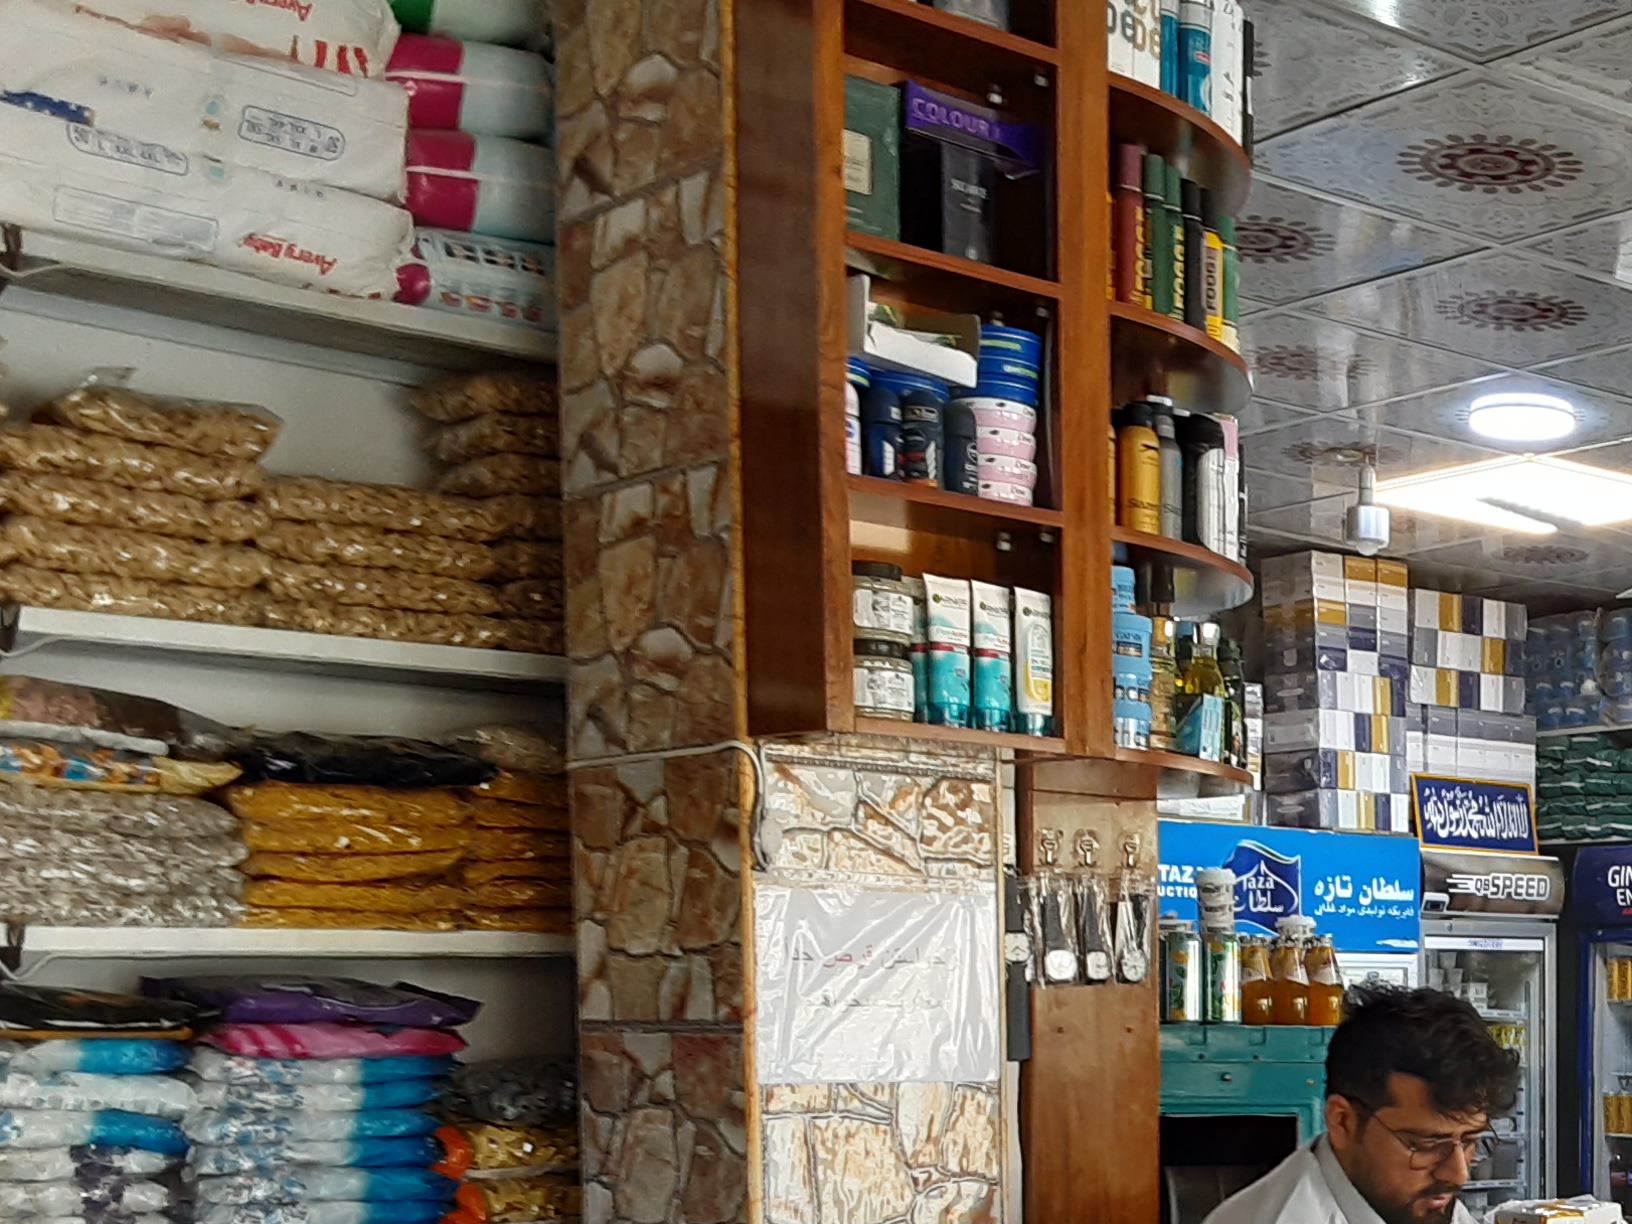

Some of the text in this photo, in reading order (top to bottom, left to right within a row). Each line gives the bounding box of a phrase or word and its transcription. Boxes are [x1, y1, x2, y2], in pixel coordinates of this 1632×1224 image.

[1158, 865, 1204, 883] TAZ
[1314, 876, 1415, 904] سلطان تازه
